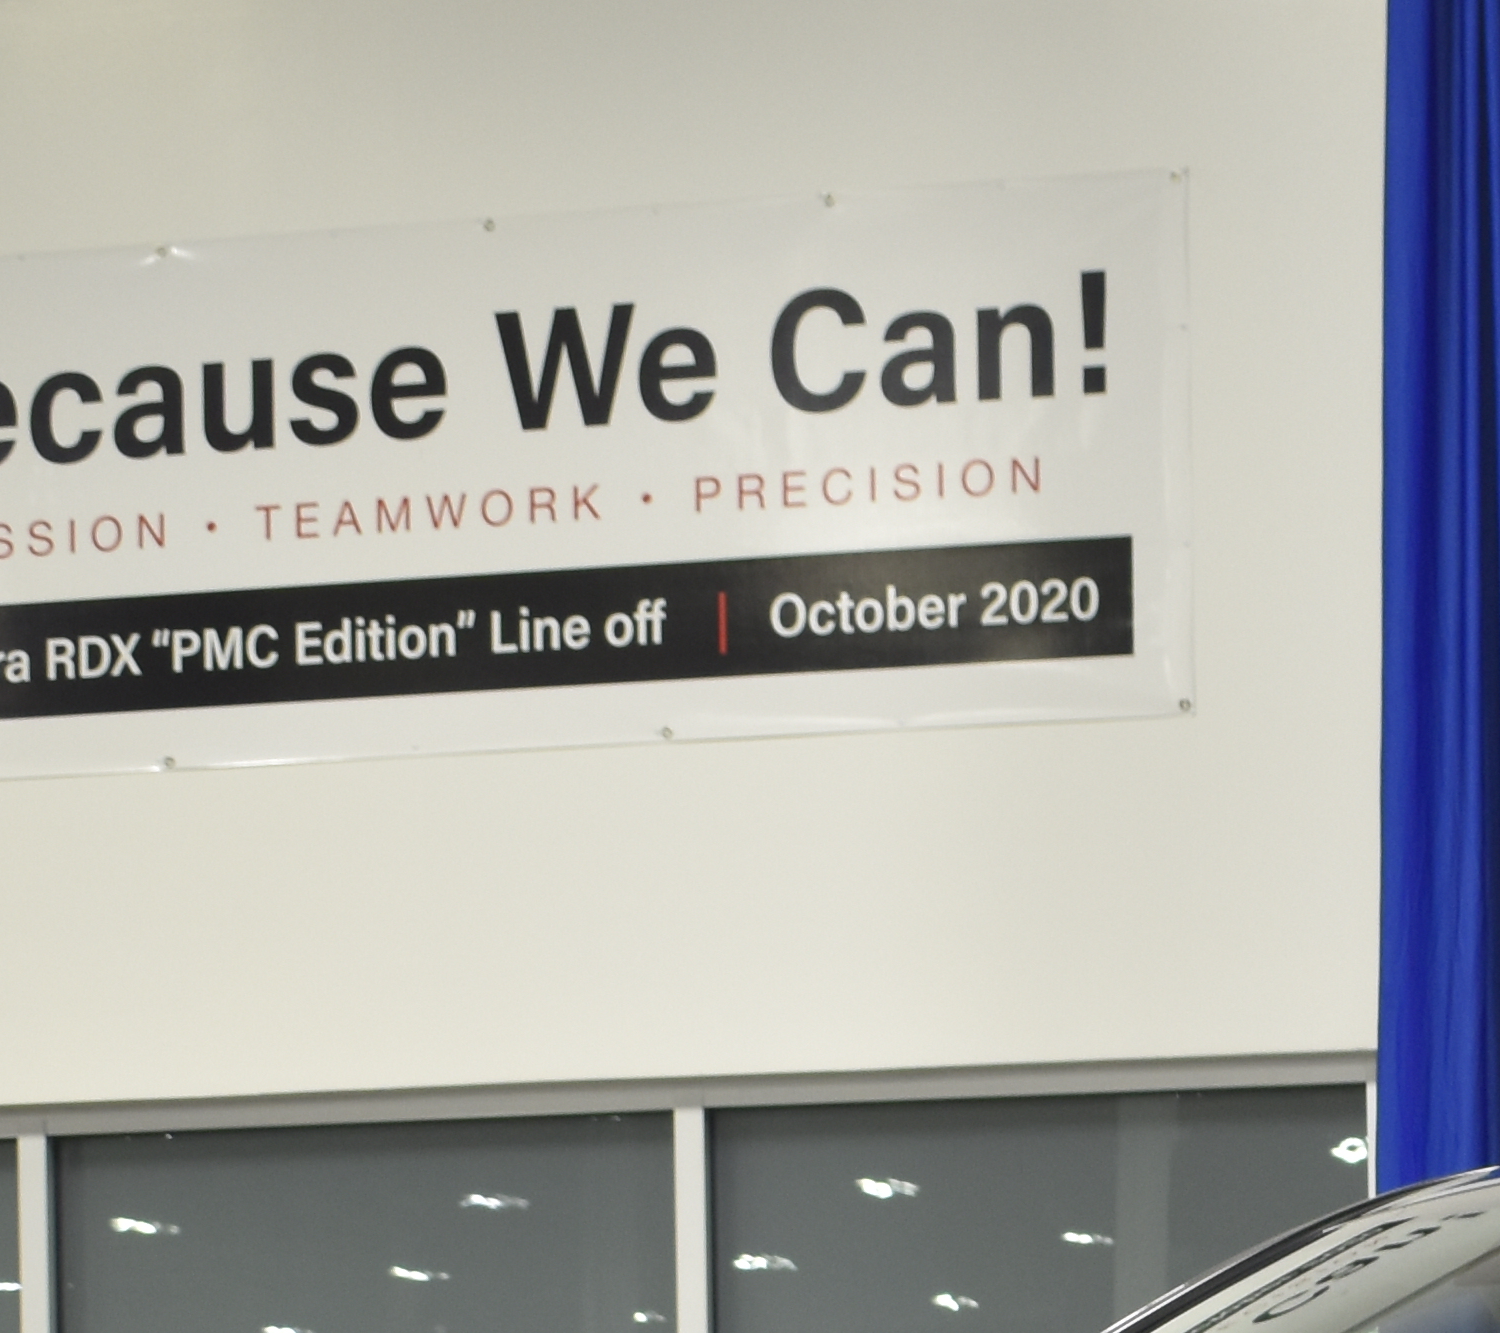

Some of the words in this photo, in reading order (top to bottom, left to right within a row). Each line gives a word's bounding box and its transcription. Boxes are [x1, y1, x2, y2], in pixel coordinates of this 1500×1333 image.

[495, 303, 718, 431] We
[771, 270, 1107, 413] Can!
[255, 484, 602, 542] TEAMWORK
[694, 456, 1041, 514] PRECISION
[46, 632, 143, 681] RDX
[489, 606, 591, 655] Line
[604, 597, 668, 648] off
[769, 583, 967, 639] October
[980, 576, 1100, 628] 2020
